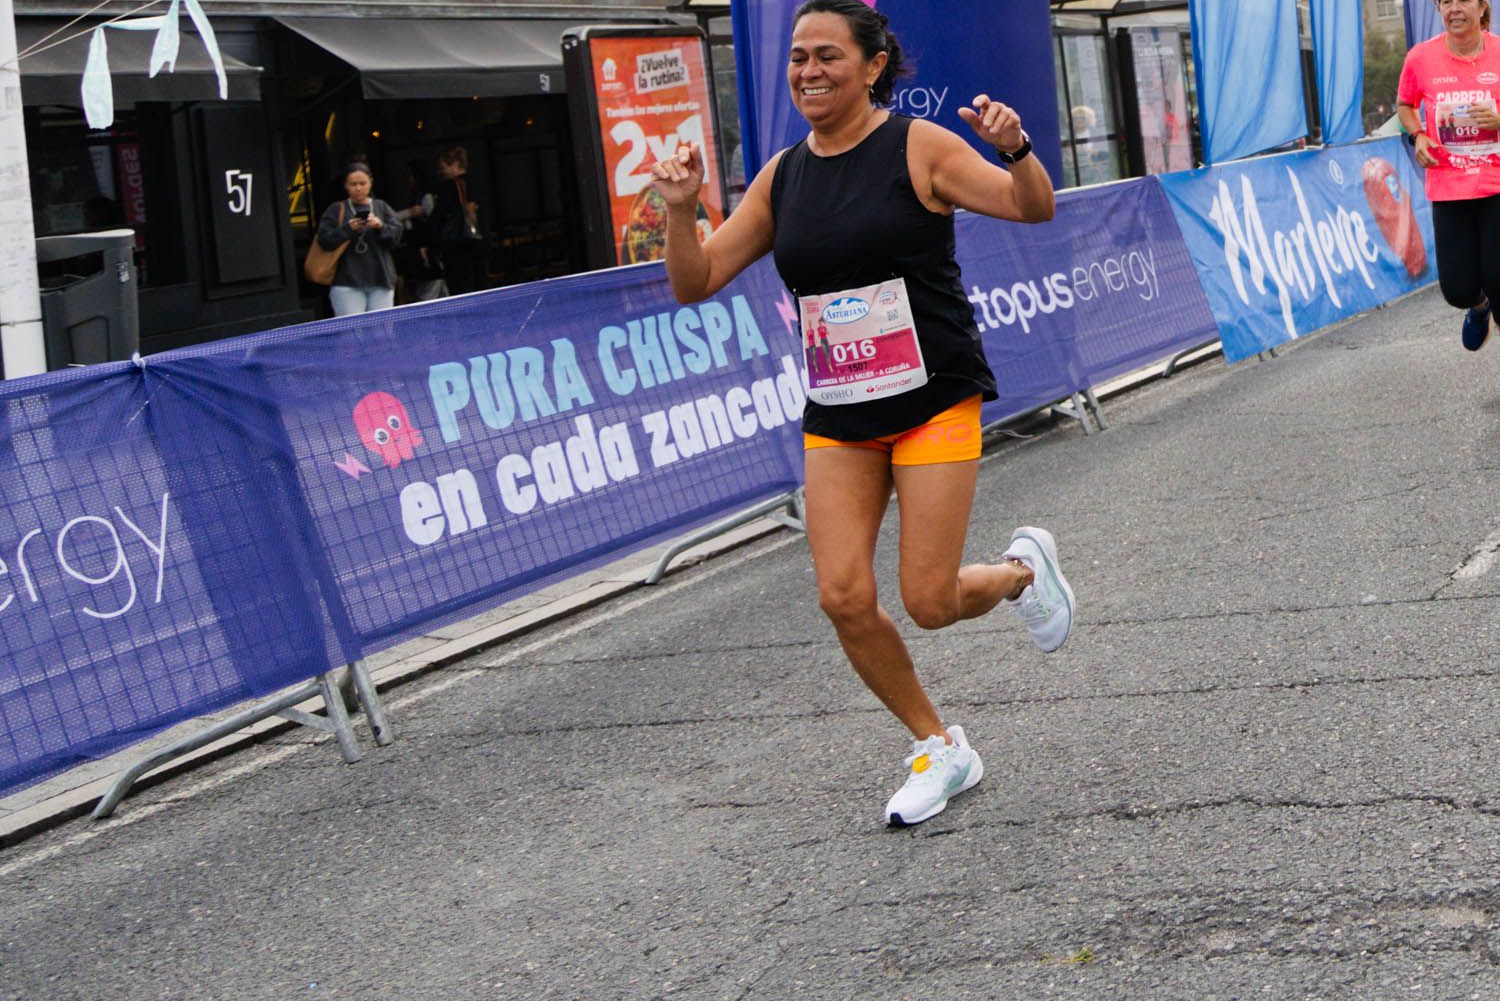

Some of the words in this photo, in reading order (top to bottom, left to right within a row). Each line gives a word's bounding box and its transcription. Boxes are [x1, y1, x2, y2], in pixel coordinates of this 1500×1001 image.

[638, 77, 648, 89] la
[1456, 126, 1479, 137] 016
[225, 169, 252, 217] 57
[1208, 166, 1380, 340] Marlene
[968, 272, 1074, 333] topus
[1072, 248, 1159, 301] energy
[428, 336, 594, 444] PURA
[597, 295, 769, 398] CHISPA
[832, 340, 877, 363] 016
[821, 388, 854, 401] OYSHO
[875, 378, 912, 392] Santander
[401, 470, 487, 546] en
[497, 413, 640, 516] cada
[0, 492, 169, 620] rgy
